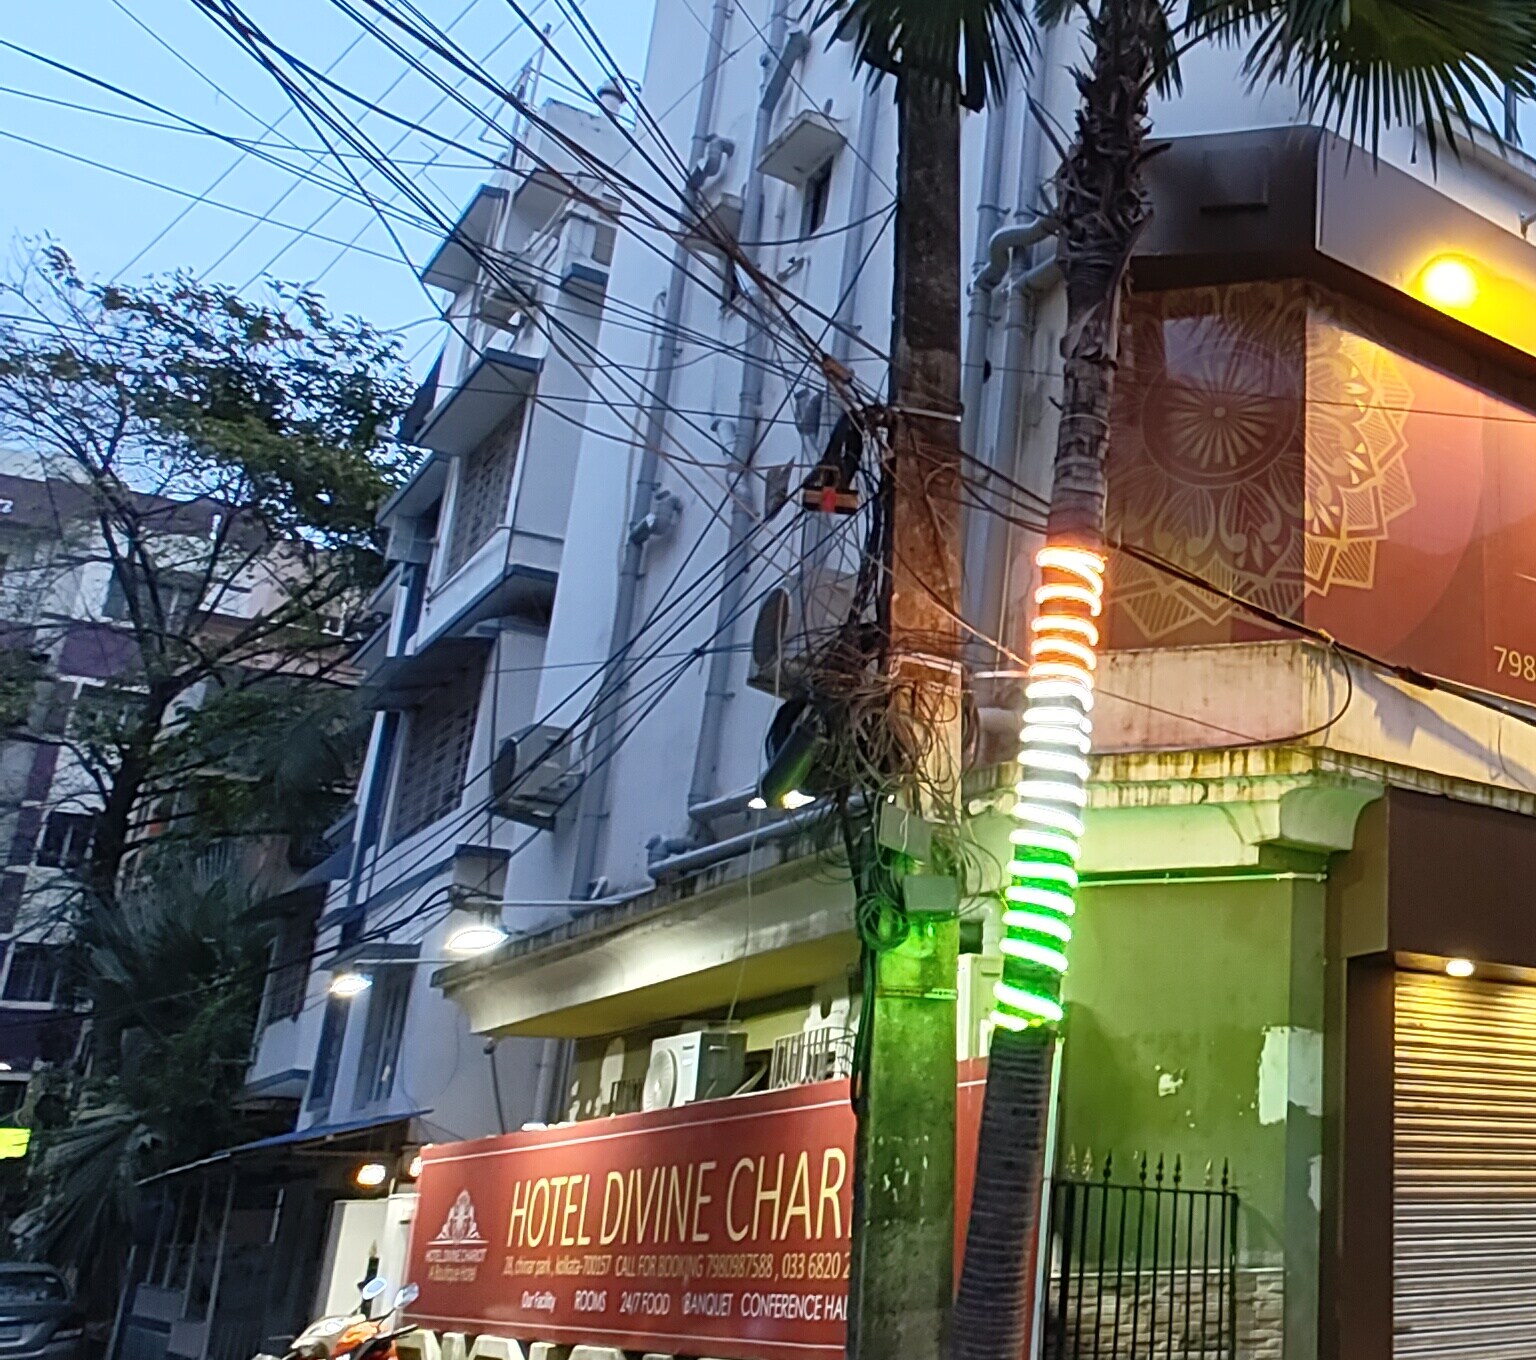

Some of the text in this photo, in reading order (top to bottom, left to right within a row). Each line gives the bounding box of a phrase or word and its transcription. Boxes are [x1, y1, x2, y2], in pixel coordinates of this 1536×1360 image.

[506, 1147, 852, 1248] HOTEL DIVINE CHAR
[615, 1254, 636, 1277] CALL
[638, 1254, 656, 1277] FOR
[658, 1254, 703, 1278] BOOKING
[781, 1252, 805, 1279] 033
[808, 1251, 841, 1279] 6820
[574, 1290, 607, 1313] ROOMS
[619, 1291, 640, 1314] 24/7
[641, 1292, 671, 1315] FOOD
[683, 1293, 733, 1317] BANQUET
[741, 1293, 822, 1321] CONFERENCE
